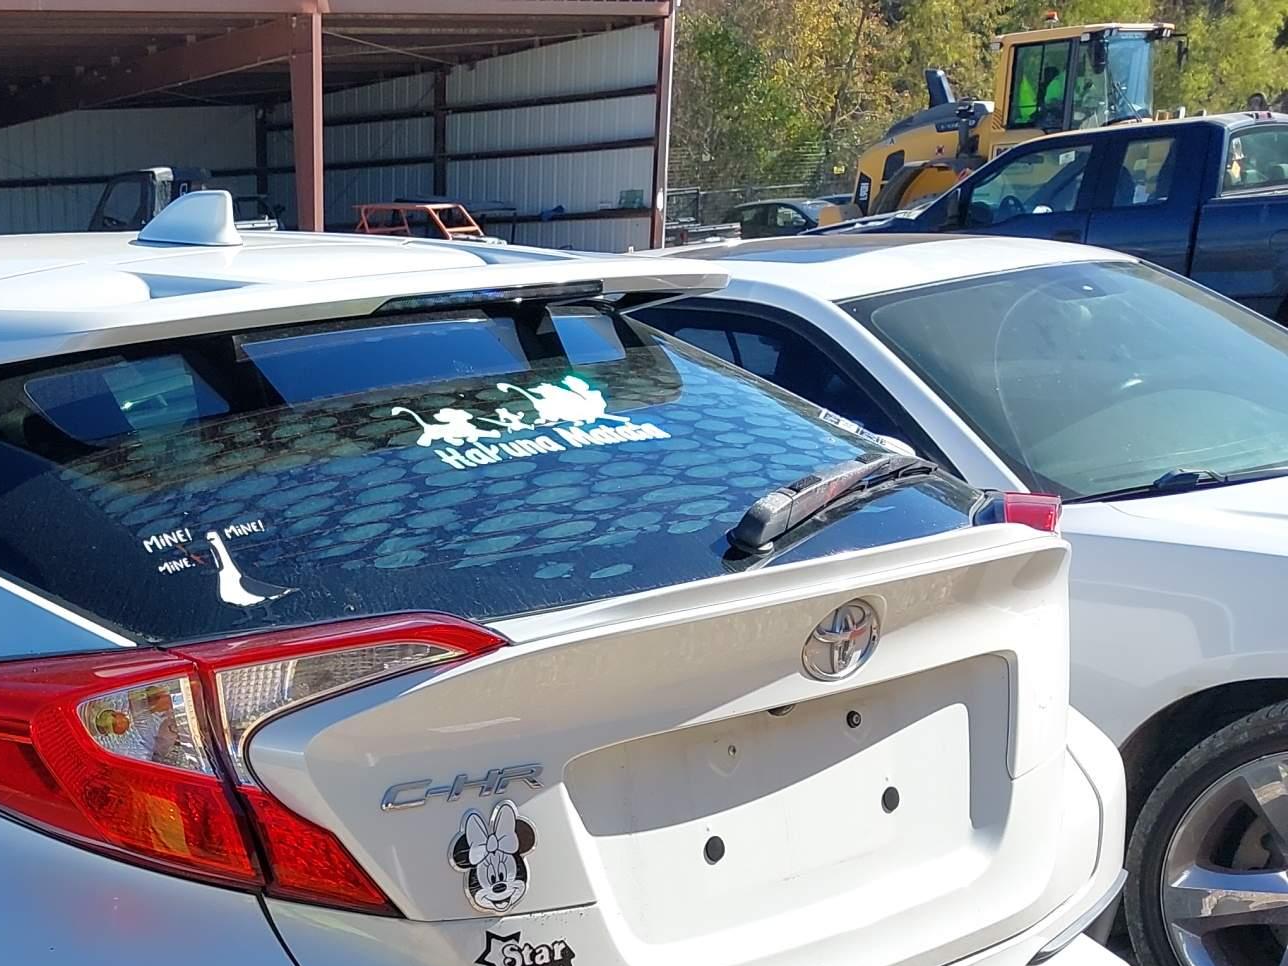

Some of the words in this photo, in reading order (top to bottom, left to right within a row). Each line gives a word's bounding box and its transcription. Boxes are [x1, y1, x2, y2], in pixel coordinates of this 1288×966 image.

[434, 434, 566, 469] Hakuna
[552, 421, 672, 448] Matata
[380, 761, 545, 811] C-HR
